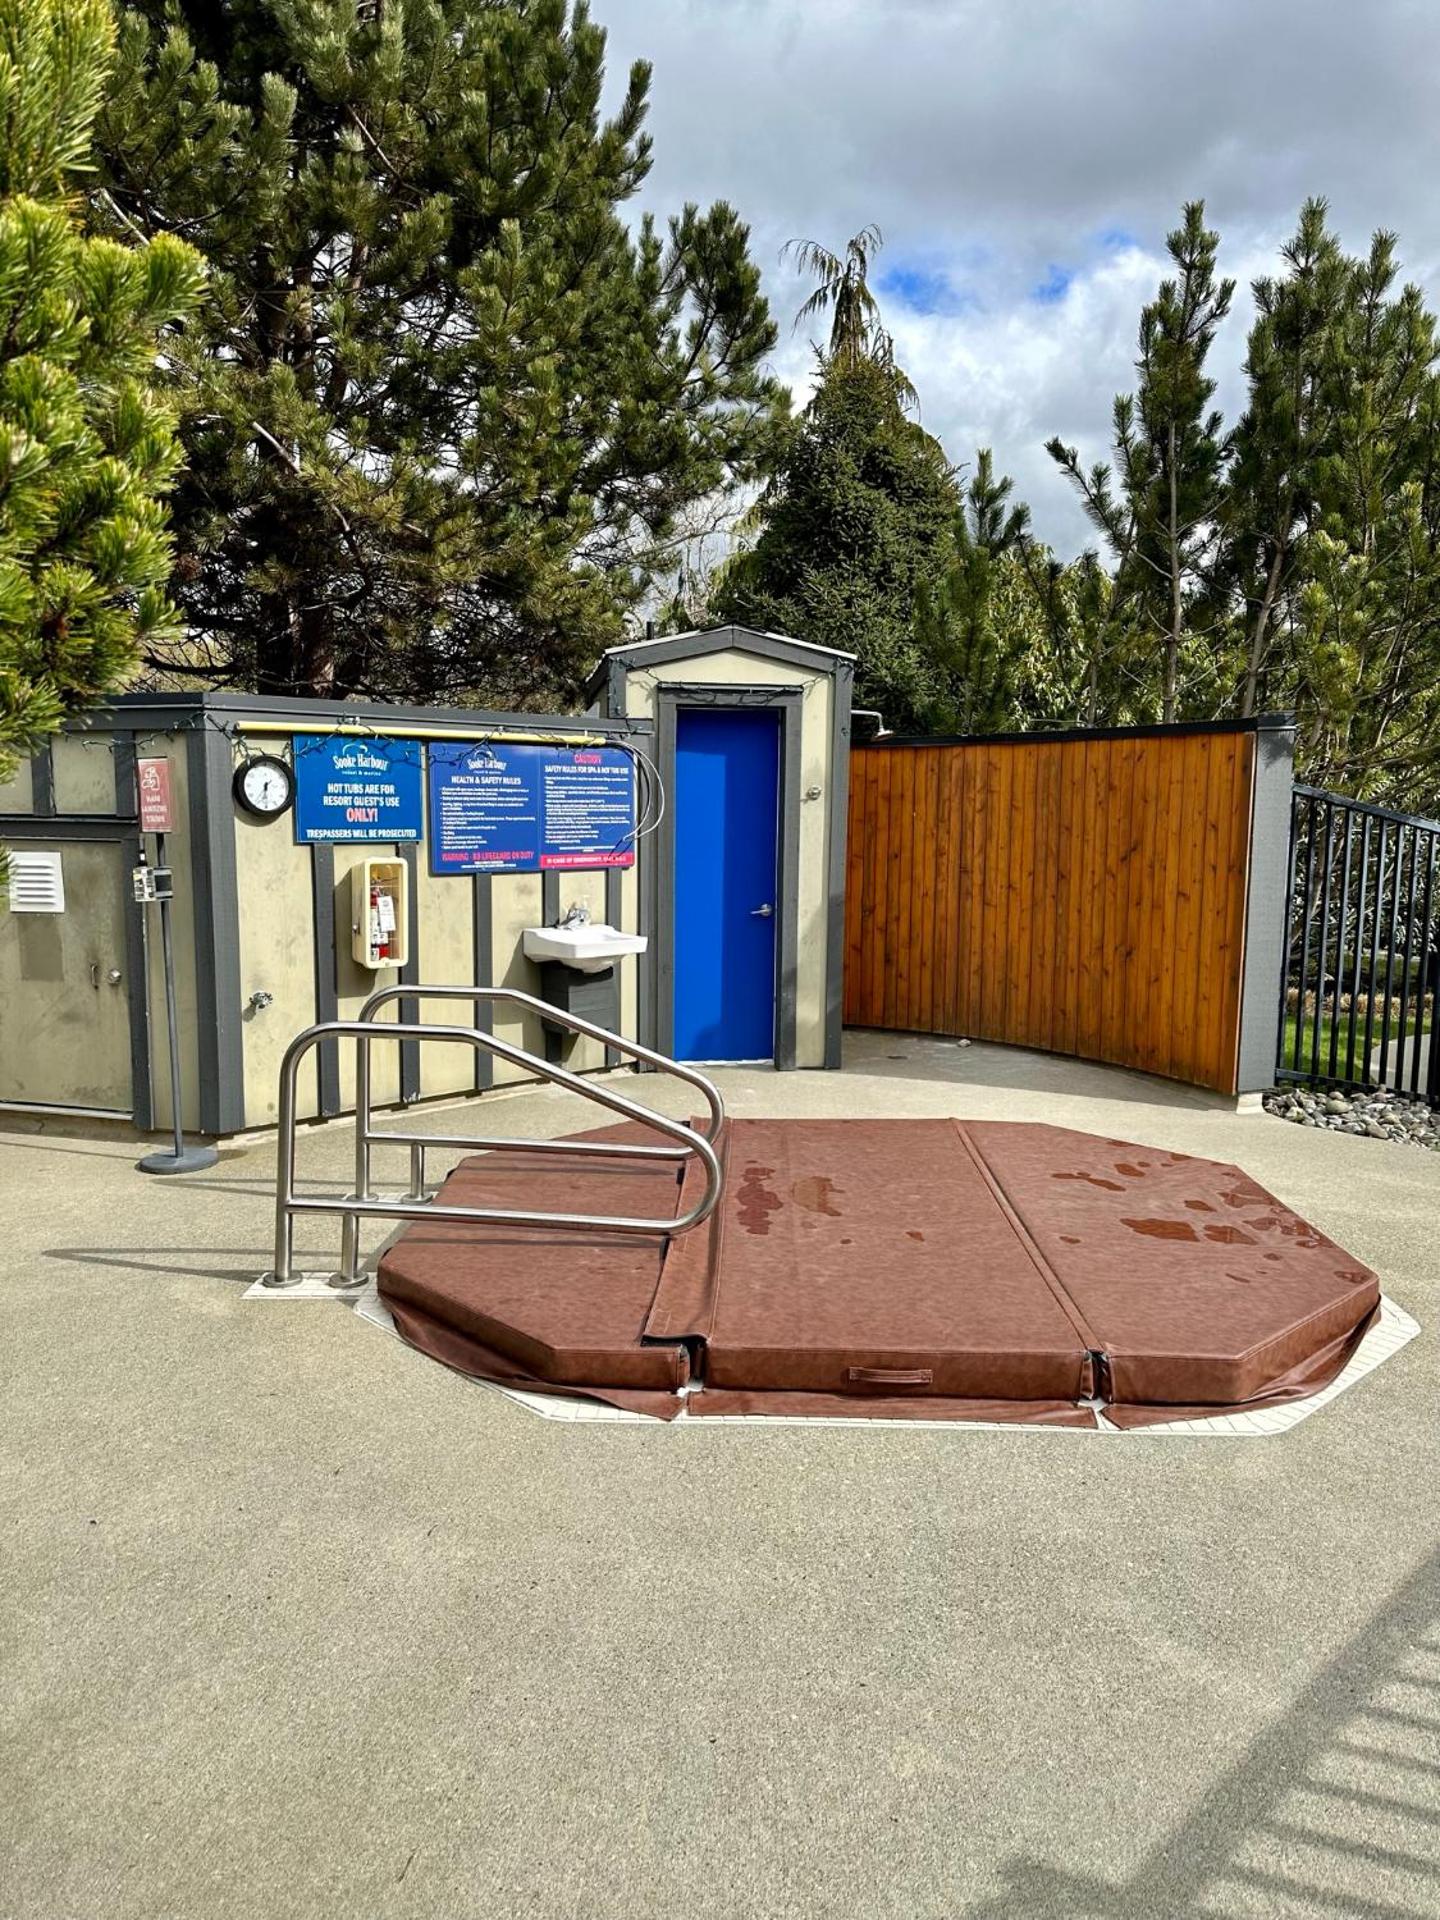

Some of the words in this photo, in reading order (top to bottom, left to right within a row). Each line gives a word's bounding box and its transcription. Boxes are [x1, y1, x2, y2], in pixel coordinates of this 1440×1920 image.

[333, 754, 357, 770] Sooke
[357, 753, 389, 771] Harbour
[544, 765, 561, 773] SAFETY
[577, 766, 587, 774] FOR
[451, 776, 474, 784] HEALTH
[474, 776, 480, 784] &
[481, 776, 502, 785] SAFETY
[503, 776, 521, 785] RULES
[327, 783, 343, 794] HOT
[344, 783, 364, 794] TUBS
[365, 784, 380, 795] ARE
[380, 784, 395, 795] FOR
[323, 796, 352, 806] RESORT
[353, 796, 385, 807] GUEST'S
[385, 796, 400, 807] USE
[346, 807, 378, 823] ONLY!
[306, 829, 352, 839] TRESPASSERS
[352, 829, 367, 838] WILL
[368, 829, 377, 838] BE
[378, 829, 417, 838] PROSECUTED
